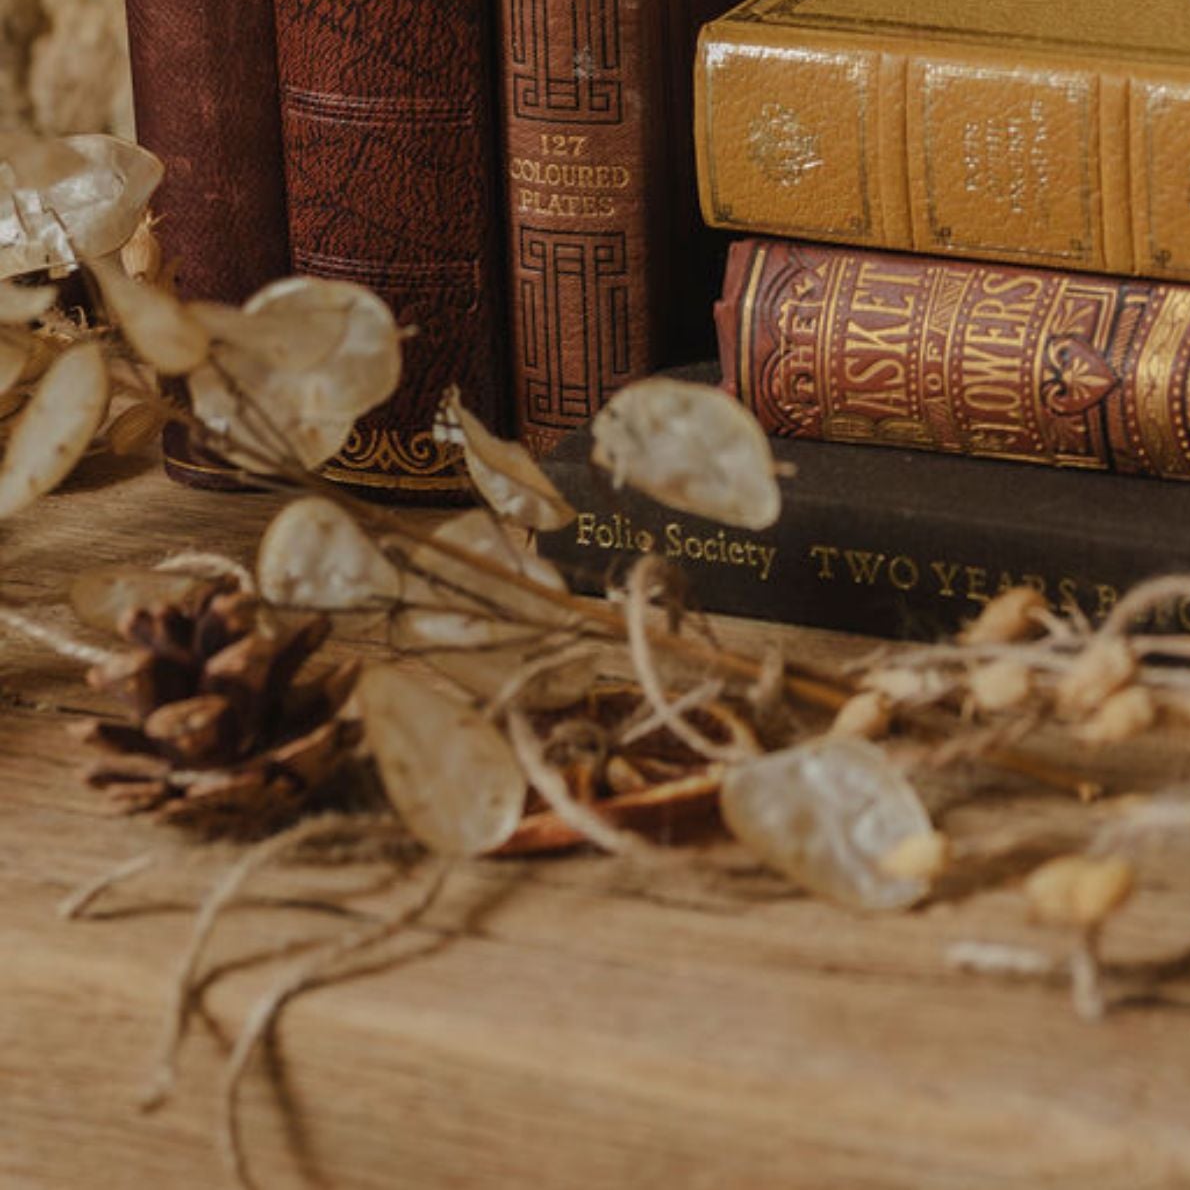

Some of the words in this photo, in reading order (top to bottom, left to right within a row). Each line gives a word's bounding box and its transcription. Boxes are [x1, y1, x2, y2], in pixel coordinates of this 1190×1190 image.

[538, 133, 588, 158] 127
[510, 158, 630, 190] COLOURED
[518, 188, 616, 218] PLATES
[924, 340, 943, 392] OF
[575, 512, 656, 552] Folio
[665, 523, 778, 580] Society
[809, 545, 920, 592] TWO
